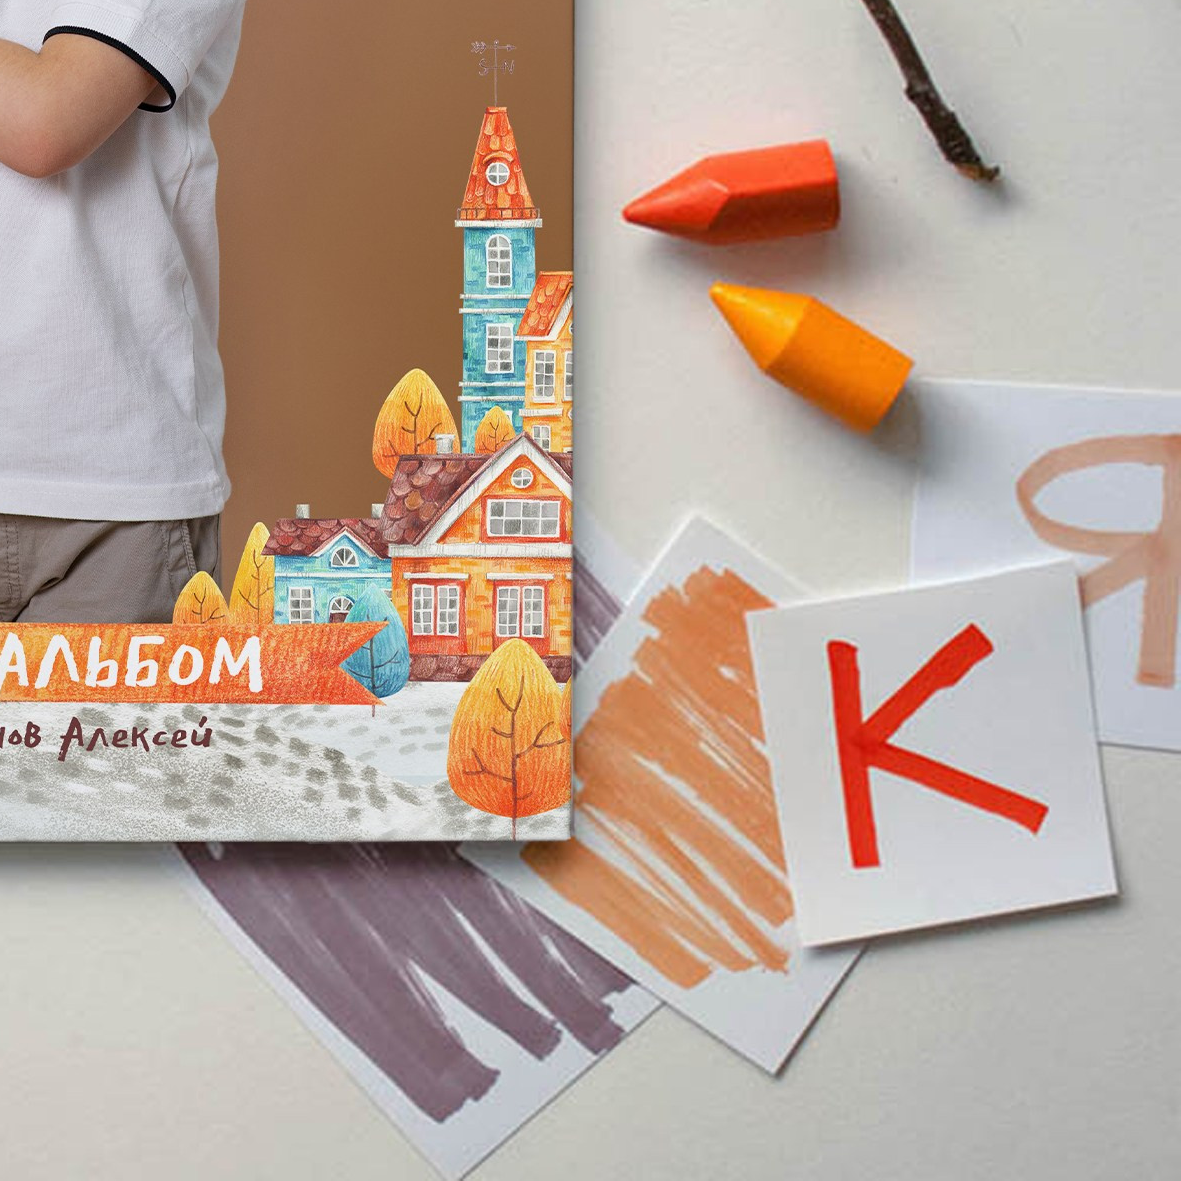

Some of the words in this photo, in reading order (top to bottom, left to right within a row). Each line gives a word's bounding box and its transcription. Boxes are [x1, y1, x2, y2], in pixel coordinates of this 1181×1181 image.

[1015, 433, 1181, 688] Я
[58, 716, 213, 761] Алексей
[827, 623, 1050, 869] К
